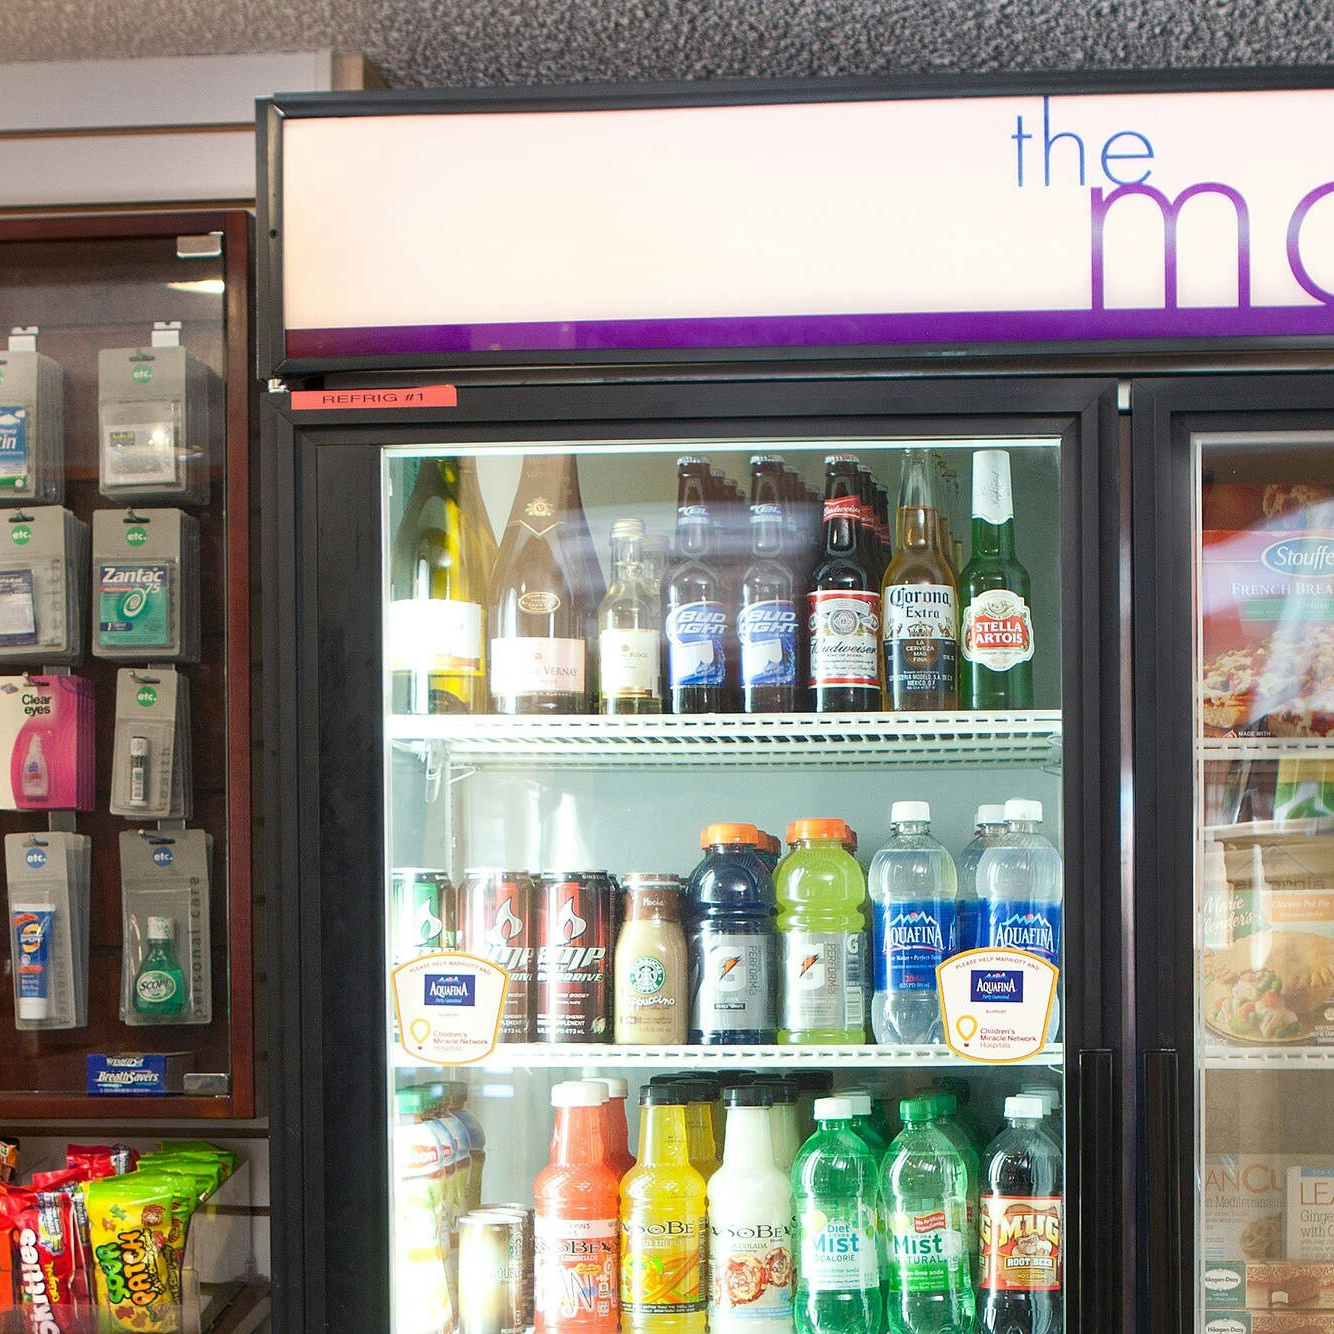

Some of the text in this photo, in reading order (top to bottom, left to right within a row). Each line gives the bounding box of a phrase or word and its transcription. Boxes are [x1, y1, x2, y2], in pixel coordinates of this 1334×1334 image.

[1012, 94, 1154, 188] the
[133, 369, 153, 379] etc.
[323, 393, 423, 404] REFRIG #1
[12, 531, 31, 540] etc.
[127, 532, 147, 540] etc.
[102, 567, 165, 584] Zantac
[1231, 583, 1292, 595] FRENCH
[890, 587, 951, 609] Corona
[906, 606, 940, 620] Extra
[975, 622, 1023, 634] STELLA
[974, 632, 1023, 644] ARTOIS
[22, 694, 51, 705] Clear
[24, 705, 51, 716] eyes
[883, 922, 945, 952] AQUAFINA
[994, 922, 1054, 949] AQUAFINA
[955, 959, 977, 970] PLEASE
[995, 957, 1024, 966] MARRIOTT
[429, 981, 469, 997] AQUAFINA
[975, 977, 1016, 993] AQUAFINA
[827, 1224, 850, 1234] Diet
[998, 1215, 1060, 1248] MUG
[1300, 1225, 1325, 1238] with
[118, 1229, 161, 1308] PATCH
[1007, 1257, 1053, 1267] ROOT BEER
[96, 1242, 130, 1304] SOUR
